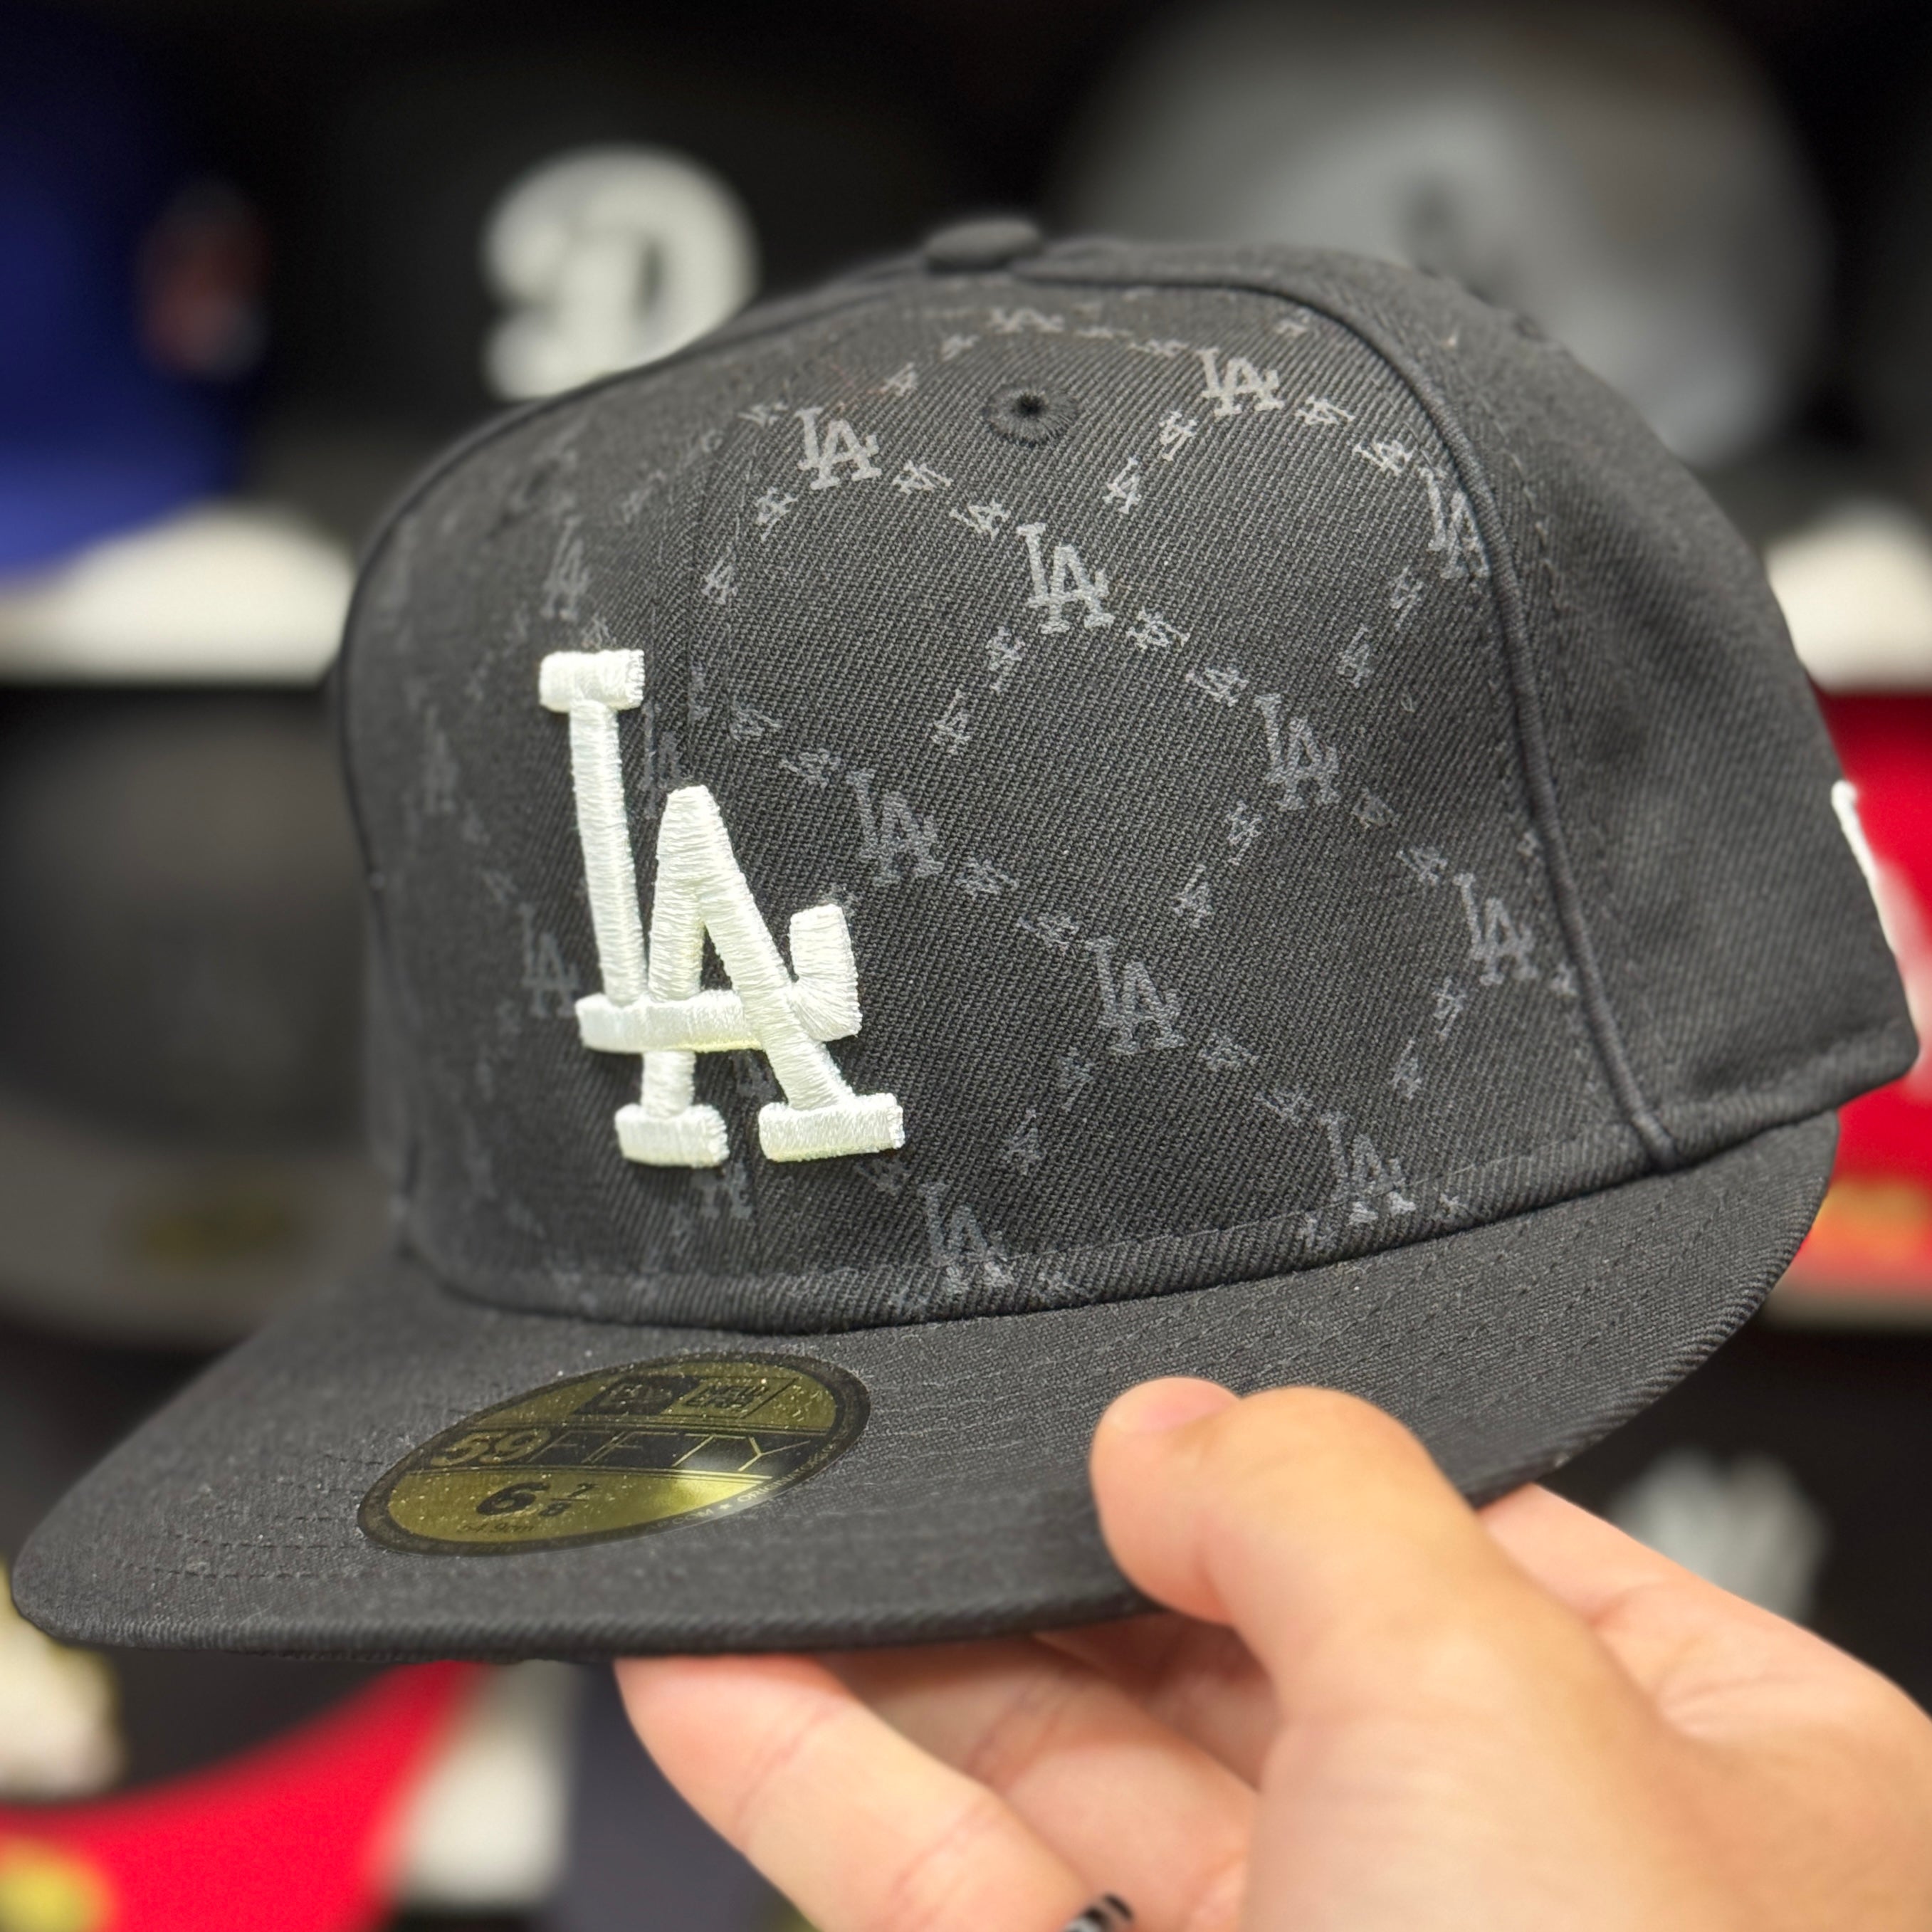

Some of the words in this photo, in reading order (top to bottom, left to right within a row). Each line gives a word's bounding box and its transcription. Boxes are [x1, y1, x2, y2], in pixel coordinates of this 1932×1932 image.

[1196, 347, 1285, 418] LA
[792, 404, 883, 490] LA
[1017, 522, 1115, 634] LA
[1253, 693, 1340, 812] LA
[849, 767, 944, 887] LA
[540, 649, 905, 1167] LA
[1452, 872, 1539, 987] LA
[1088, 936, 1187, 1055] LA
[1321, 1112, 1417, 1226] LA
[918, 1182, 1014, 1294] LA
[476, 1481, 550, 1515] 6
